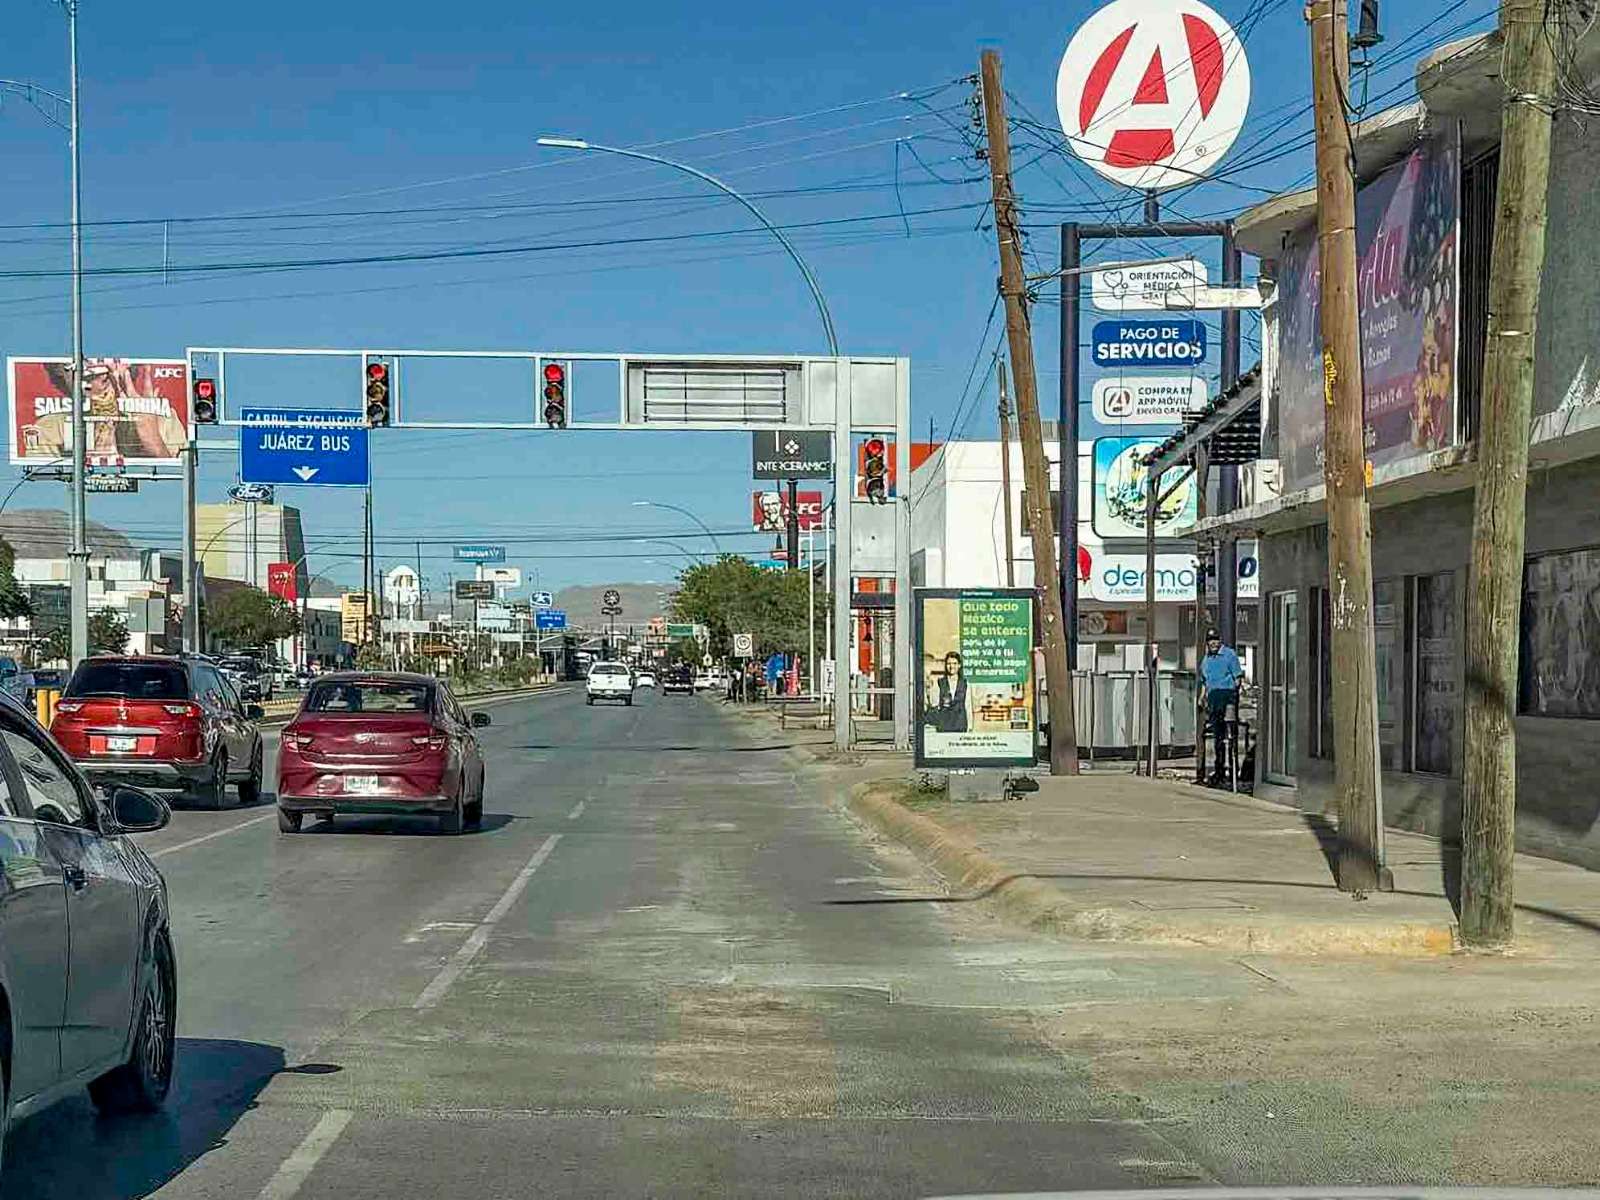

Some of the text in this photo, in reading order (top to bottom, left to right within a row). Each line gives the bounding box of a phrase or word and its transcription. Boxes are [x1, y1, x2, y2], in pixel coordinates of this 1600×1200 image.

[1120, 328, 1179, 340] PAGO DE
[1097, 342, 1202, 359] SERVICIOS
[154, 368, 184, 378] KFC
[1138, 387, 1179, 395] COMPRA
[1138, 396, 1189, 405] APP MÓVIL
[259, 431, 350, 451] JUÁREZ BUS
